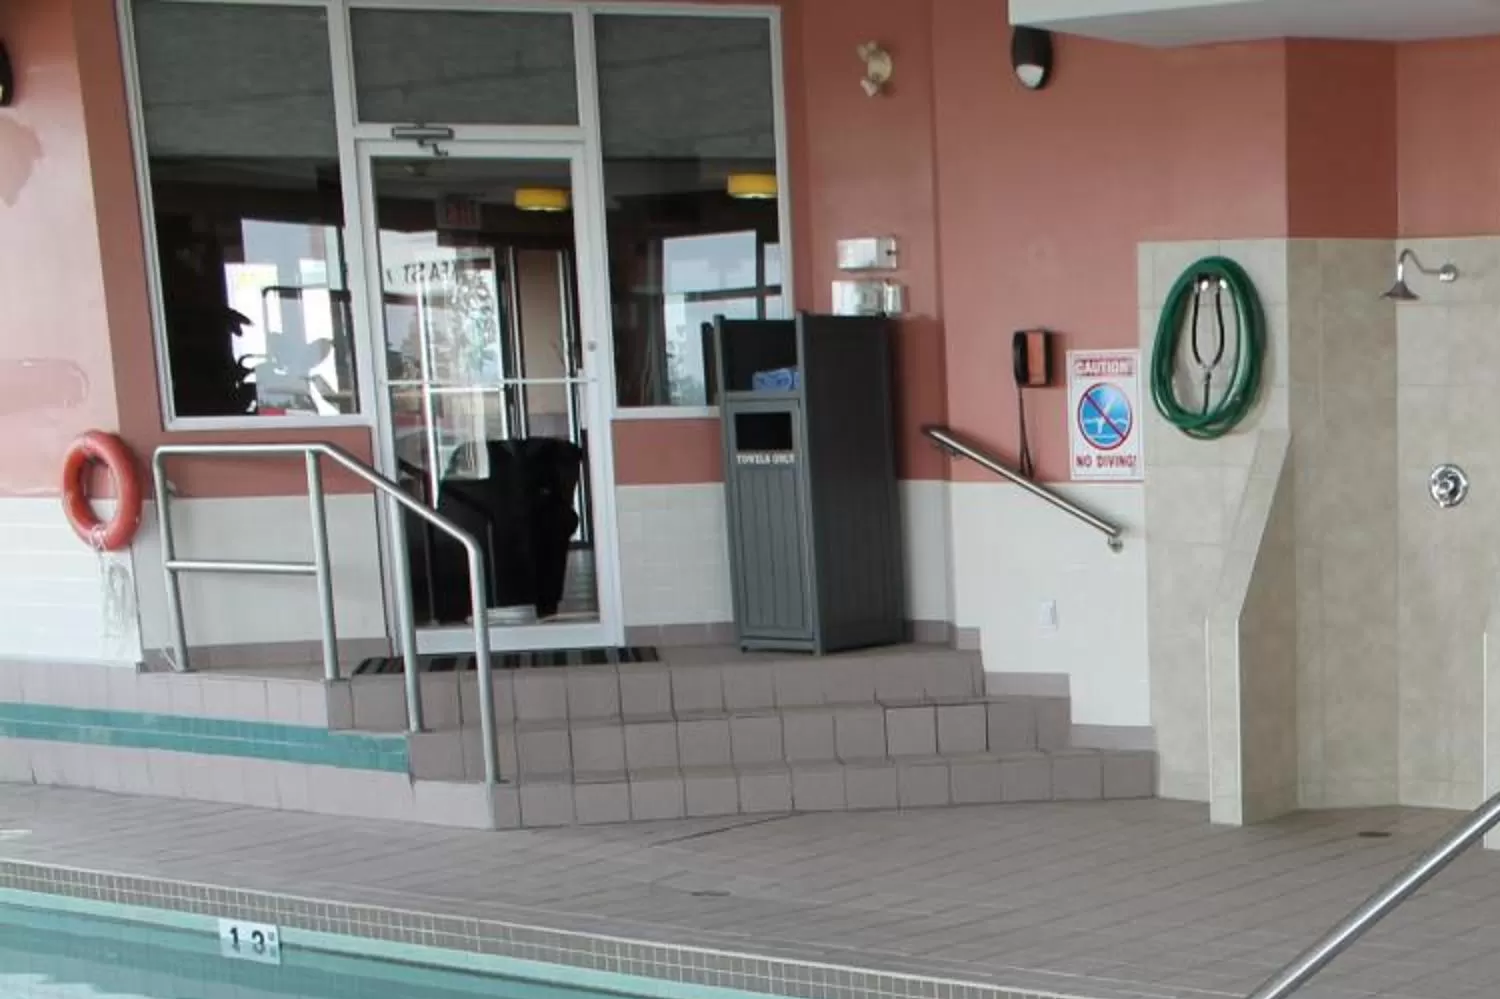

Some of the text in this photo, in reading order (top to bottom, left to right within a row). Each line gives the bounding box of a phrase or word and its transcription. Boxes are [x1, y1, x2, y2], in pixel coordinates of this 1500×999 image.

[736, 453, 795, 465] TOWELS ONLY
[1076, 454, 1136, 468] NO DIVING!
